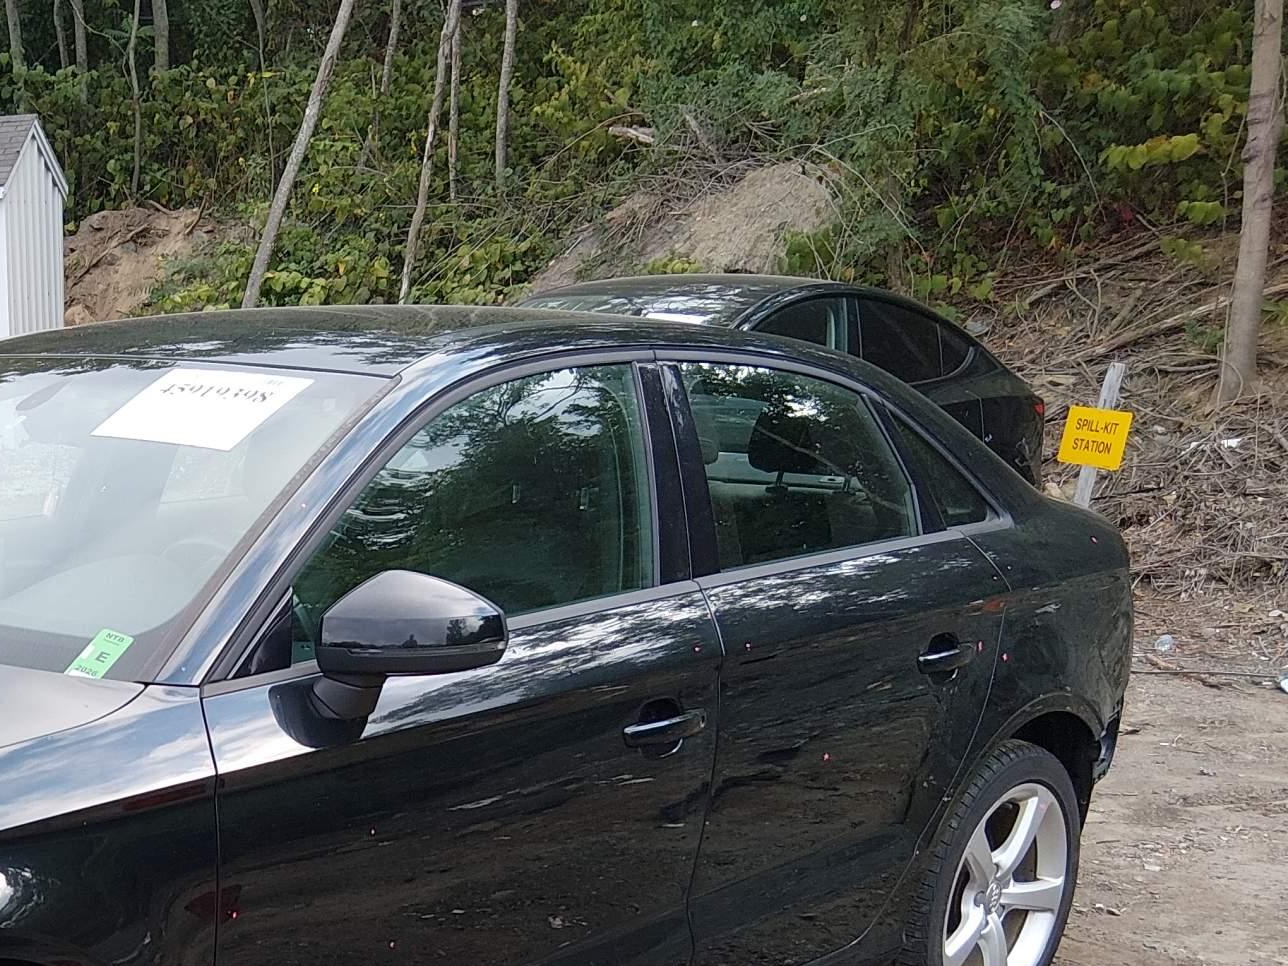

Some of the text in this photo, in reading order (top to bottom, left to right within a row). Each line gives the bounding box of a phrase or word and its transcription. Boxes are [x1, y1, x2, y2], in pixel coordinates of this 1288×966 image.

[1075, 418, 1119, 435] SPILL-KIT
[1072, 438, 1112, 455] STATION
[95, 651, 111, 663] E
